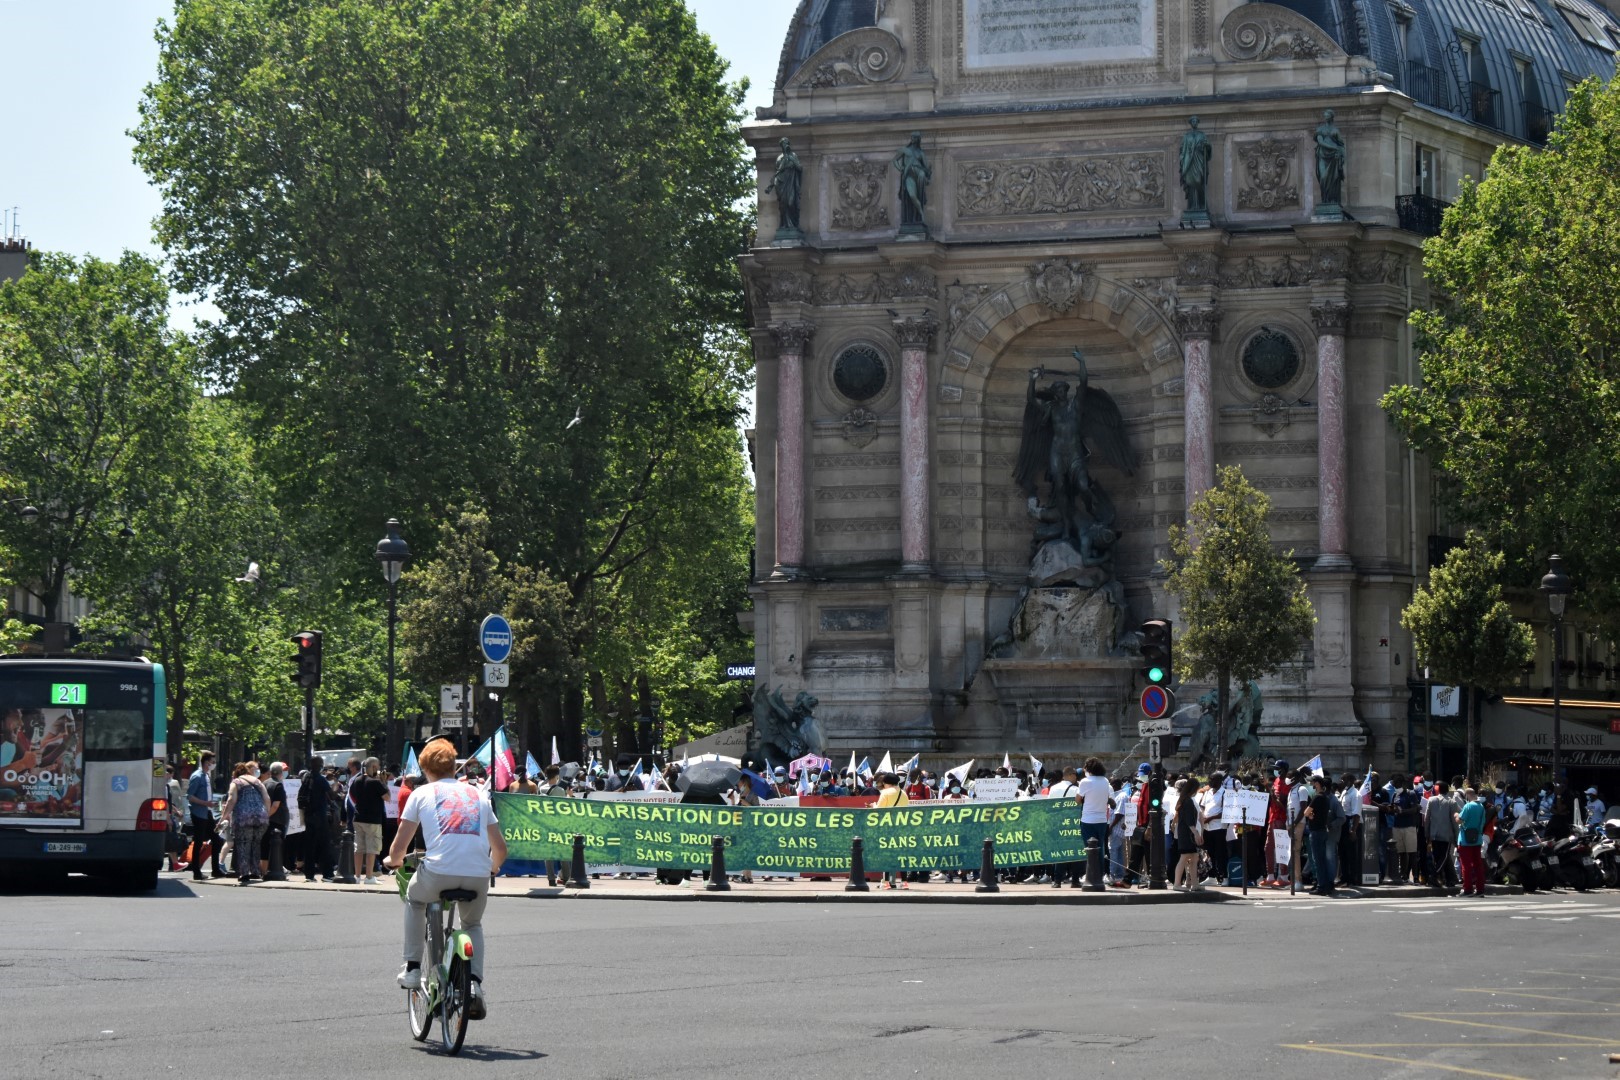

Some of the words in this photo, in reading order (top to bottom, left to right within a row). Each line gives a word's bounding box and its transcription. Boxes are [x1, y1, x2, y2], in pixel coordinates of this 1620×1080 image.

[727, 666, 756, 676] CHANGE
[59, 686, 79, 702] 21
[1527, 733, 1548, 745] CAFE
[527, 799, 712, 824] REGULARISATION
[717, 810, 743, 826] DE
[750, 811, 807, 828] TOUS
[816, 812, 854, 828] LES
[866, 810, 923, 827] SANS
[930, 806, 1022, 826] PAPIERS
[504, 828, 541, 842] SANS
[548, 832, 605, 847] PAPRS
[635, 830, 672, 843] SANS
[680, 832, 732, 846] DROIS
[778, 836, 818, 848] SANS
[878, 836, 917, 849] SANS
[922, 834, 959, 848] VRAI
[995, 830, 1032, 844] SANS
[636, 848, 673, 862] SANS
[756, 855, 852, 868] COUVERTURE
[898, 855, 963, 868] TRAVAIL
[994, 850, 1044, 864] AVENIR
